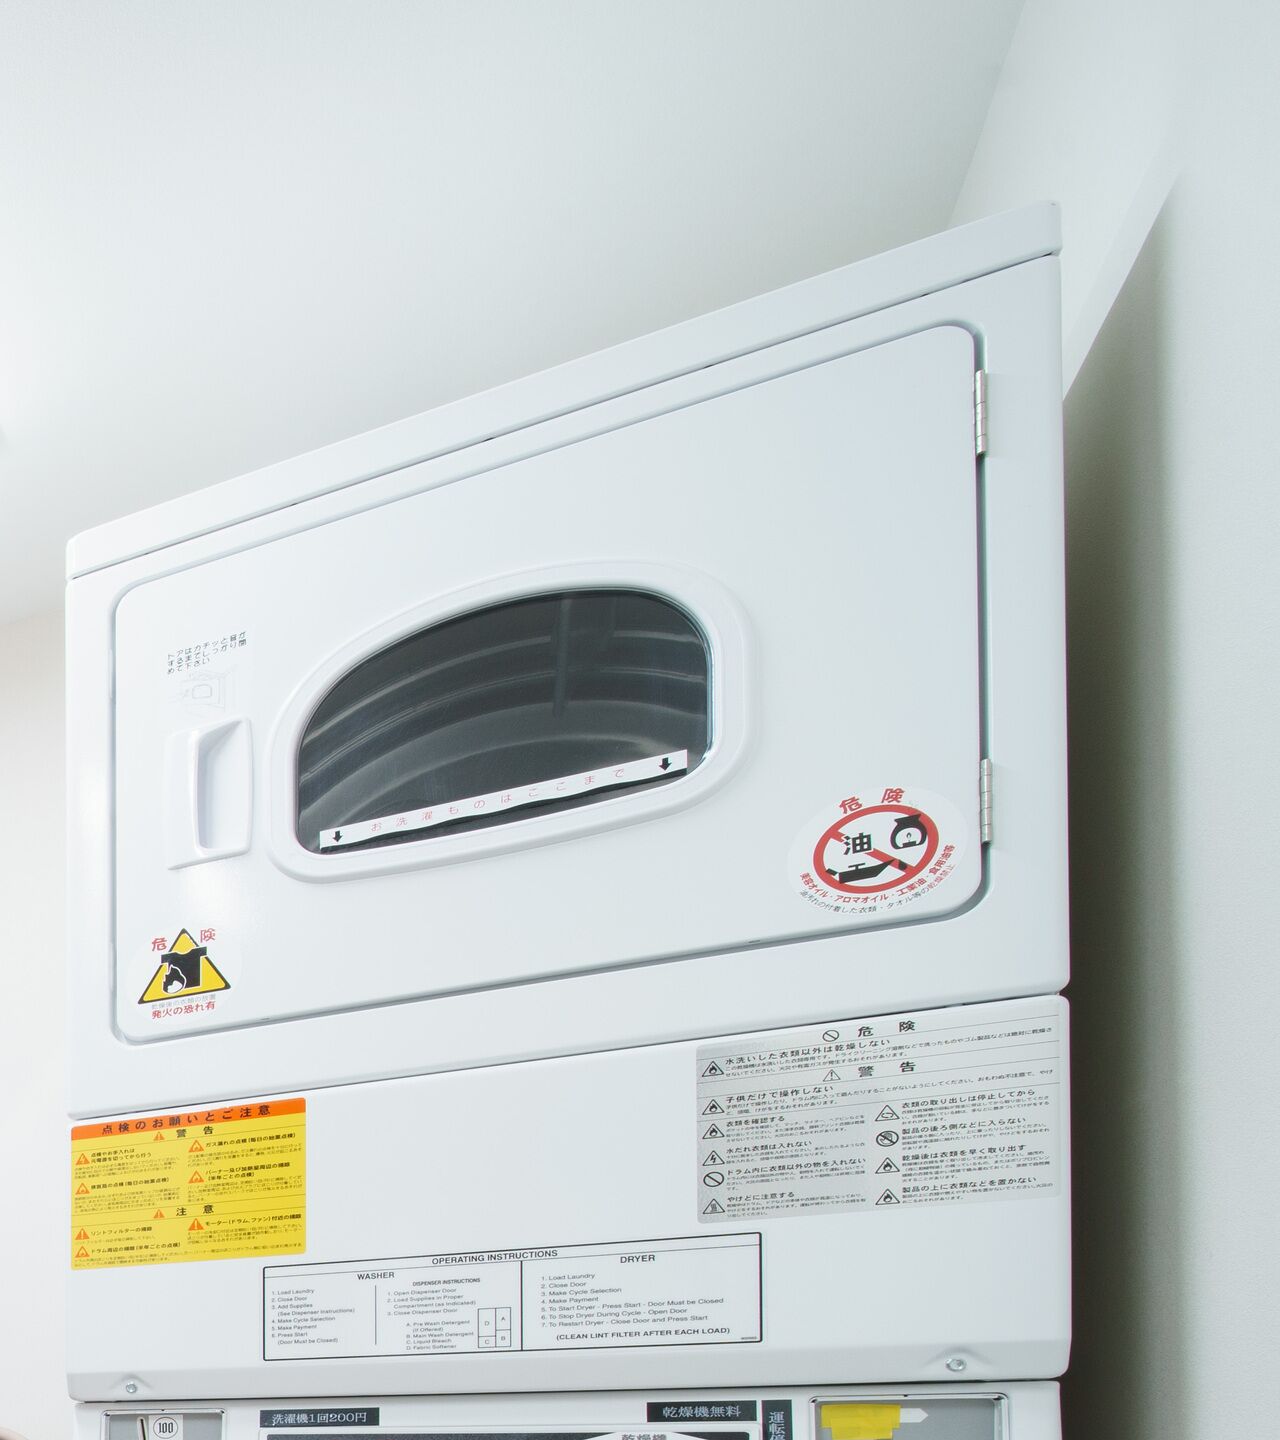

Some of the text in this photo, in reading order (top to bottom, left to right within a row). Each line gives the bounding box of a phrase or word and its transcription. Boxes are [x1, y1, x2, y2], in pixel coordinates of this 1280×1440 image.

[370, 768, 626, 832] お洗濯ものはここまで
[839, 788, 905, 814] 危険
[843, 832, 872, 855] 油
[152, 928, 216, 951] 危険
[152, 1001, 216, 1019] 発火の恐れ有
[858, 1020, 915, 1038] 危険
[725, 1039, 890, 1065] 水洗いした衣類以外は乾燥しない
[858, 1061, 916, 1078] 警告
[726, 1086, 833, 1103] 子供だけで操作しない
[902, 1089, 1035, 1109] 衣類の取り出しは停止してから
[102, 1104, 271, 1135] 点検のお願いとご注意
[726, 1116, 785, 1127] 衣類を確認する
[902, 1118, 1026, 1135] 製品の後ろ側などに入らない
[176, 1126, 213, 1138] 警告
[902, 1145, 1026, 1161] 乾燥後は衣類を早く取り出す
[727, 1158, 866, 1176] ドラム内に衣類以外の物を入れない
[902, 1177, 1036, 1193] 製品の上に衣類などを置かない
[727, 1192, 795, 1202] やけどに注意する
[176, 1204, 214, 1217] 注意
[432, 1249, 558, 1265] OPERATING INSTRUCTIONS
[620, 1254, 656, 1264] DRYER
[357, 1271, 395, 1281] WASHER
[442, 1277, 481, 1285] INSTRUCTIONS
[556, 1333, 588, 1341] (CLEAN
[702, 1327, 730, 1335] LOAD)
[271, 1411, 367, 1425] 洗濯機1回200円
[662, 1405, 741, 1418] 乾燥機無料
[157, 1421, 174, 1434] 100
